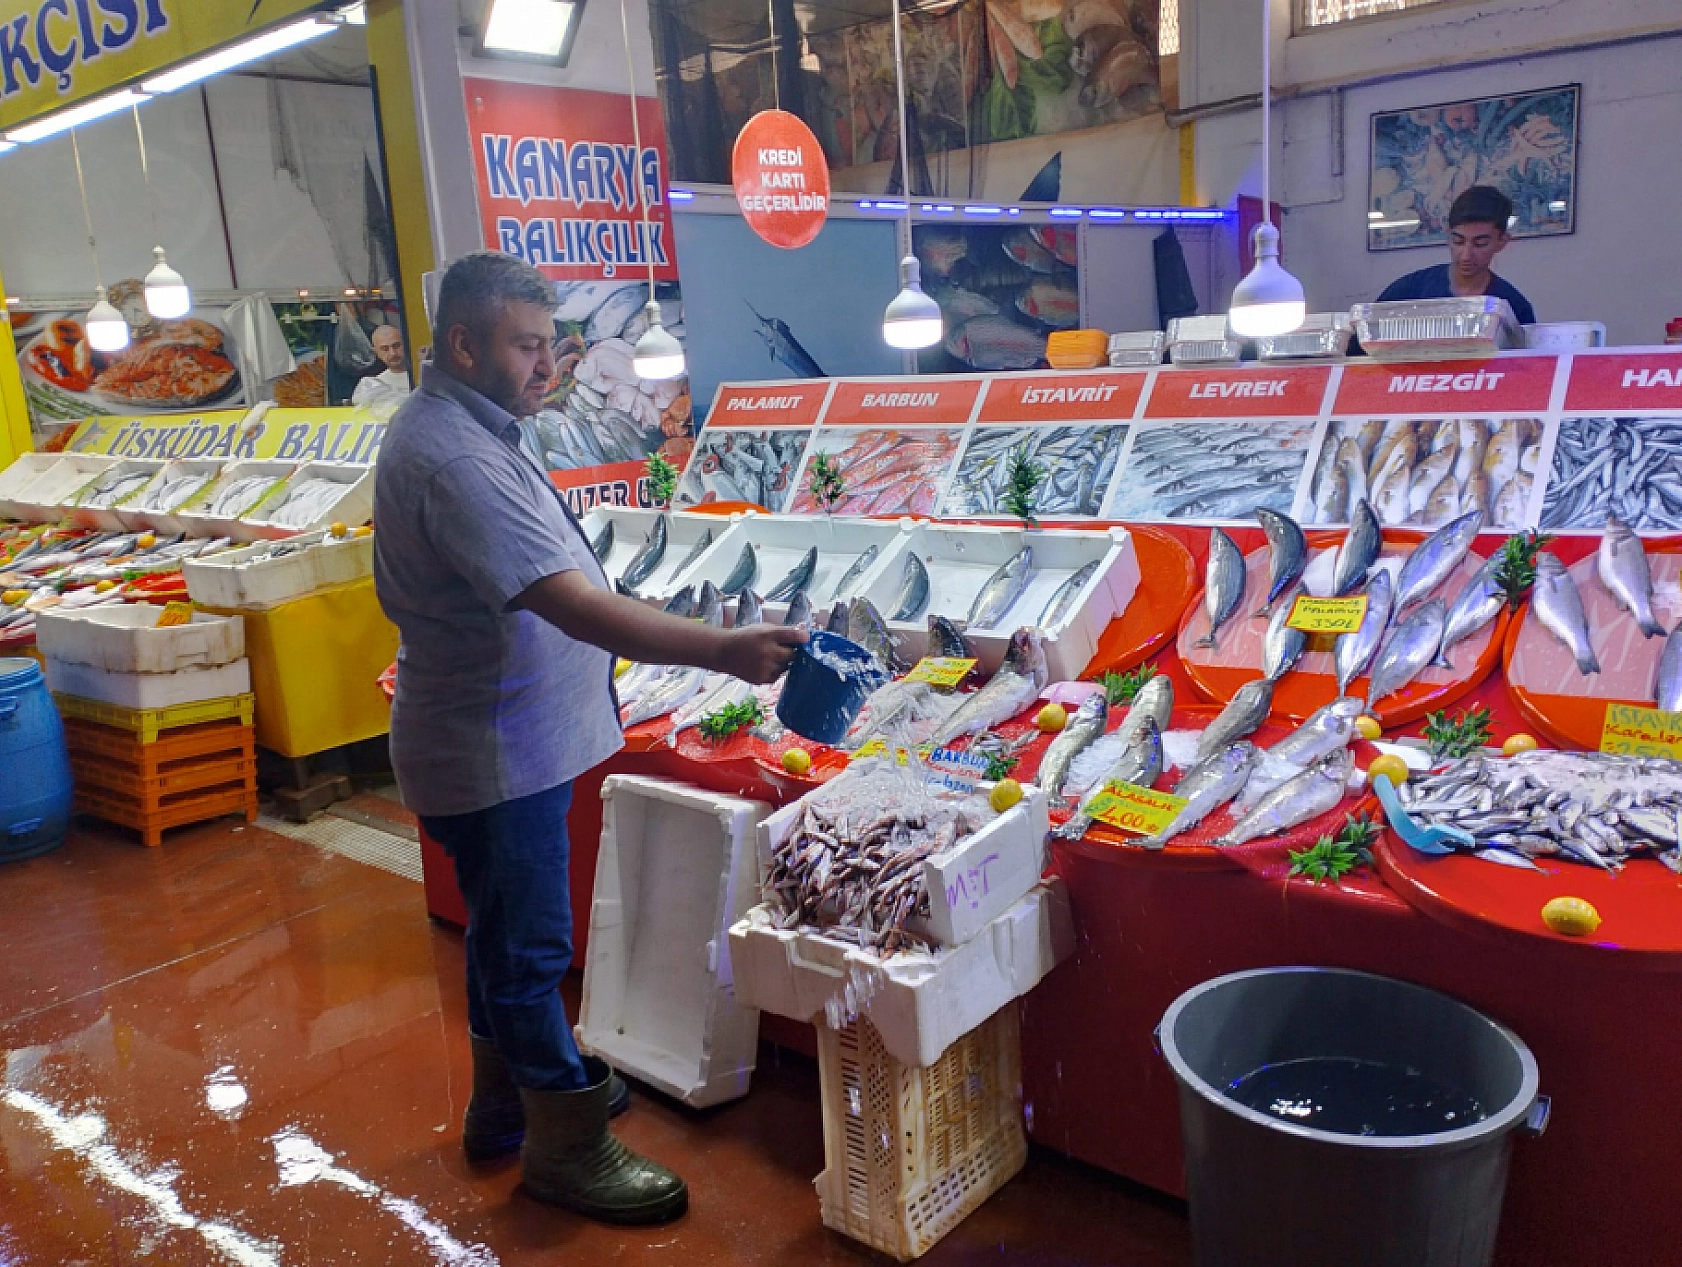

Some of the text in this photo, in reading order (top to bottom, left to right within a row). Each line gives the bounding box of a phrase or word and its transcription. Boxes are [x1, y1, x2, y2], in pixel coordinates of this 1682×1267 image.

[758, 146, 803, 166] KREDİ
[481, 133, 662, 213] KANARYA
[761, 172, 805, 188] KARTI
[743, 192, 826, 214] GEÇERLİDİR
[497, 216, 670, 277] BALIKÇILIK
[1388, 369, 1505, 393] MEZGİT
[1621, 368, 1682, 388] HA
[861, 392, 939, 407] BARBUN
[1021, 382, 1118, 404] İSTAVRİT
[1188, 380, 1289, 399] LEVREK
[726, 395, 803, 410] PALAMUT
[106, 418, 266, 459] ÜSKÜDAR
